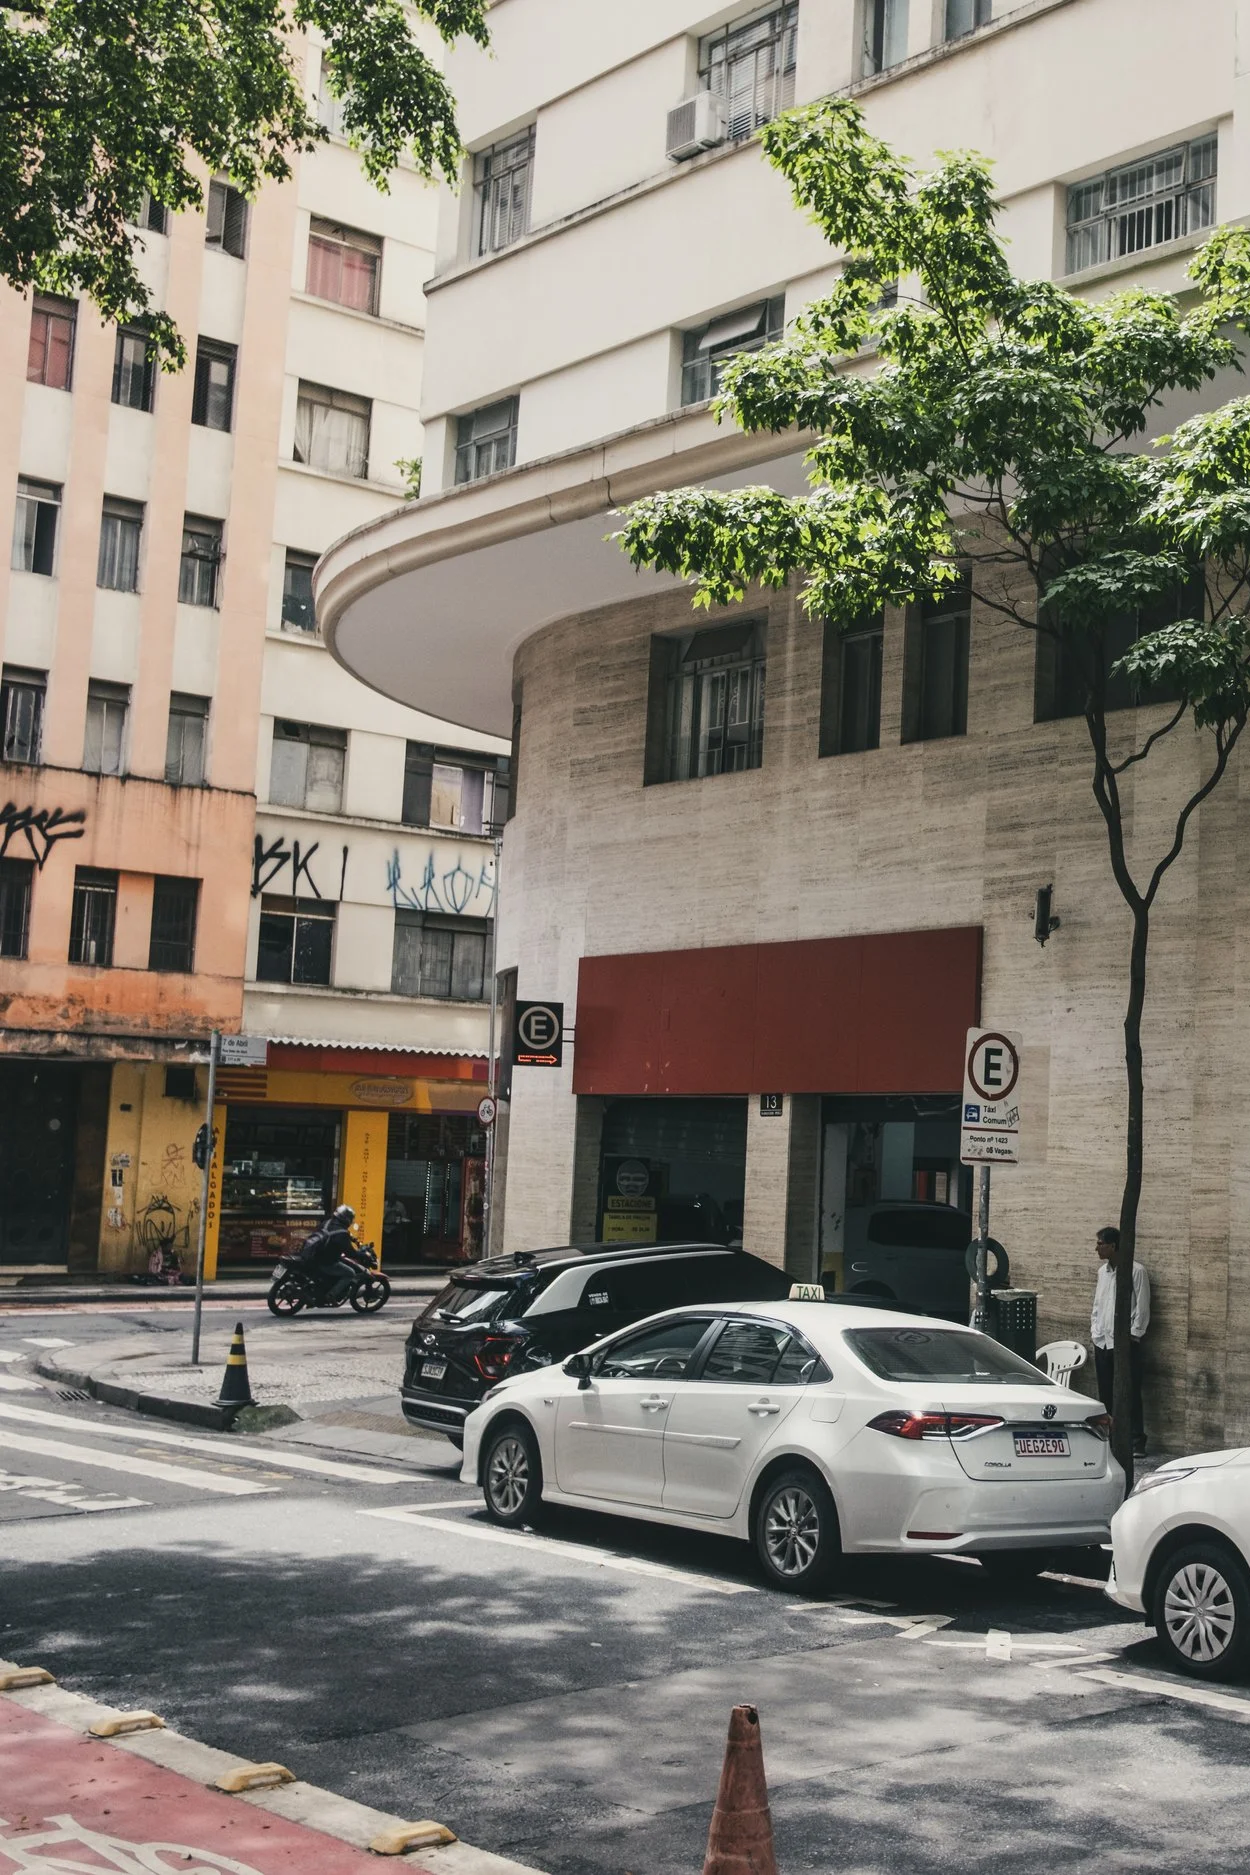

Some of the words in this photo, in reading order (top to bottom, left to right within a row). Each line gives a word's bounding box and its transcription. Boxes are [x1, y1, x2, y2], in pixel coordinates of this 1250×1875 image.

[530, 1015, 548, 1040] E
[984, 1047, 1003, 1086] E
[766, 1095, 777, 1109] 13
[982, 1116, 1007, 1125] Comum
[969, 1135, 986, 1144] Ponto
[995, 1136, 1008, 1144] 1423
[797, 1286, 820, 1300] TAXI
[1020, 1439, 1065, 1454] UEG2E90
